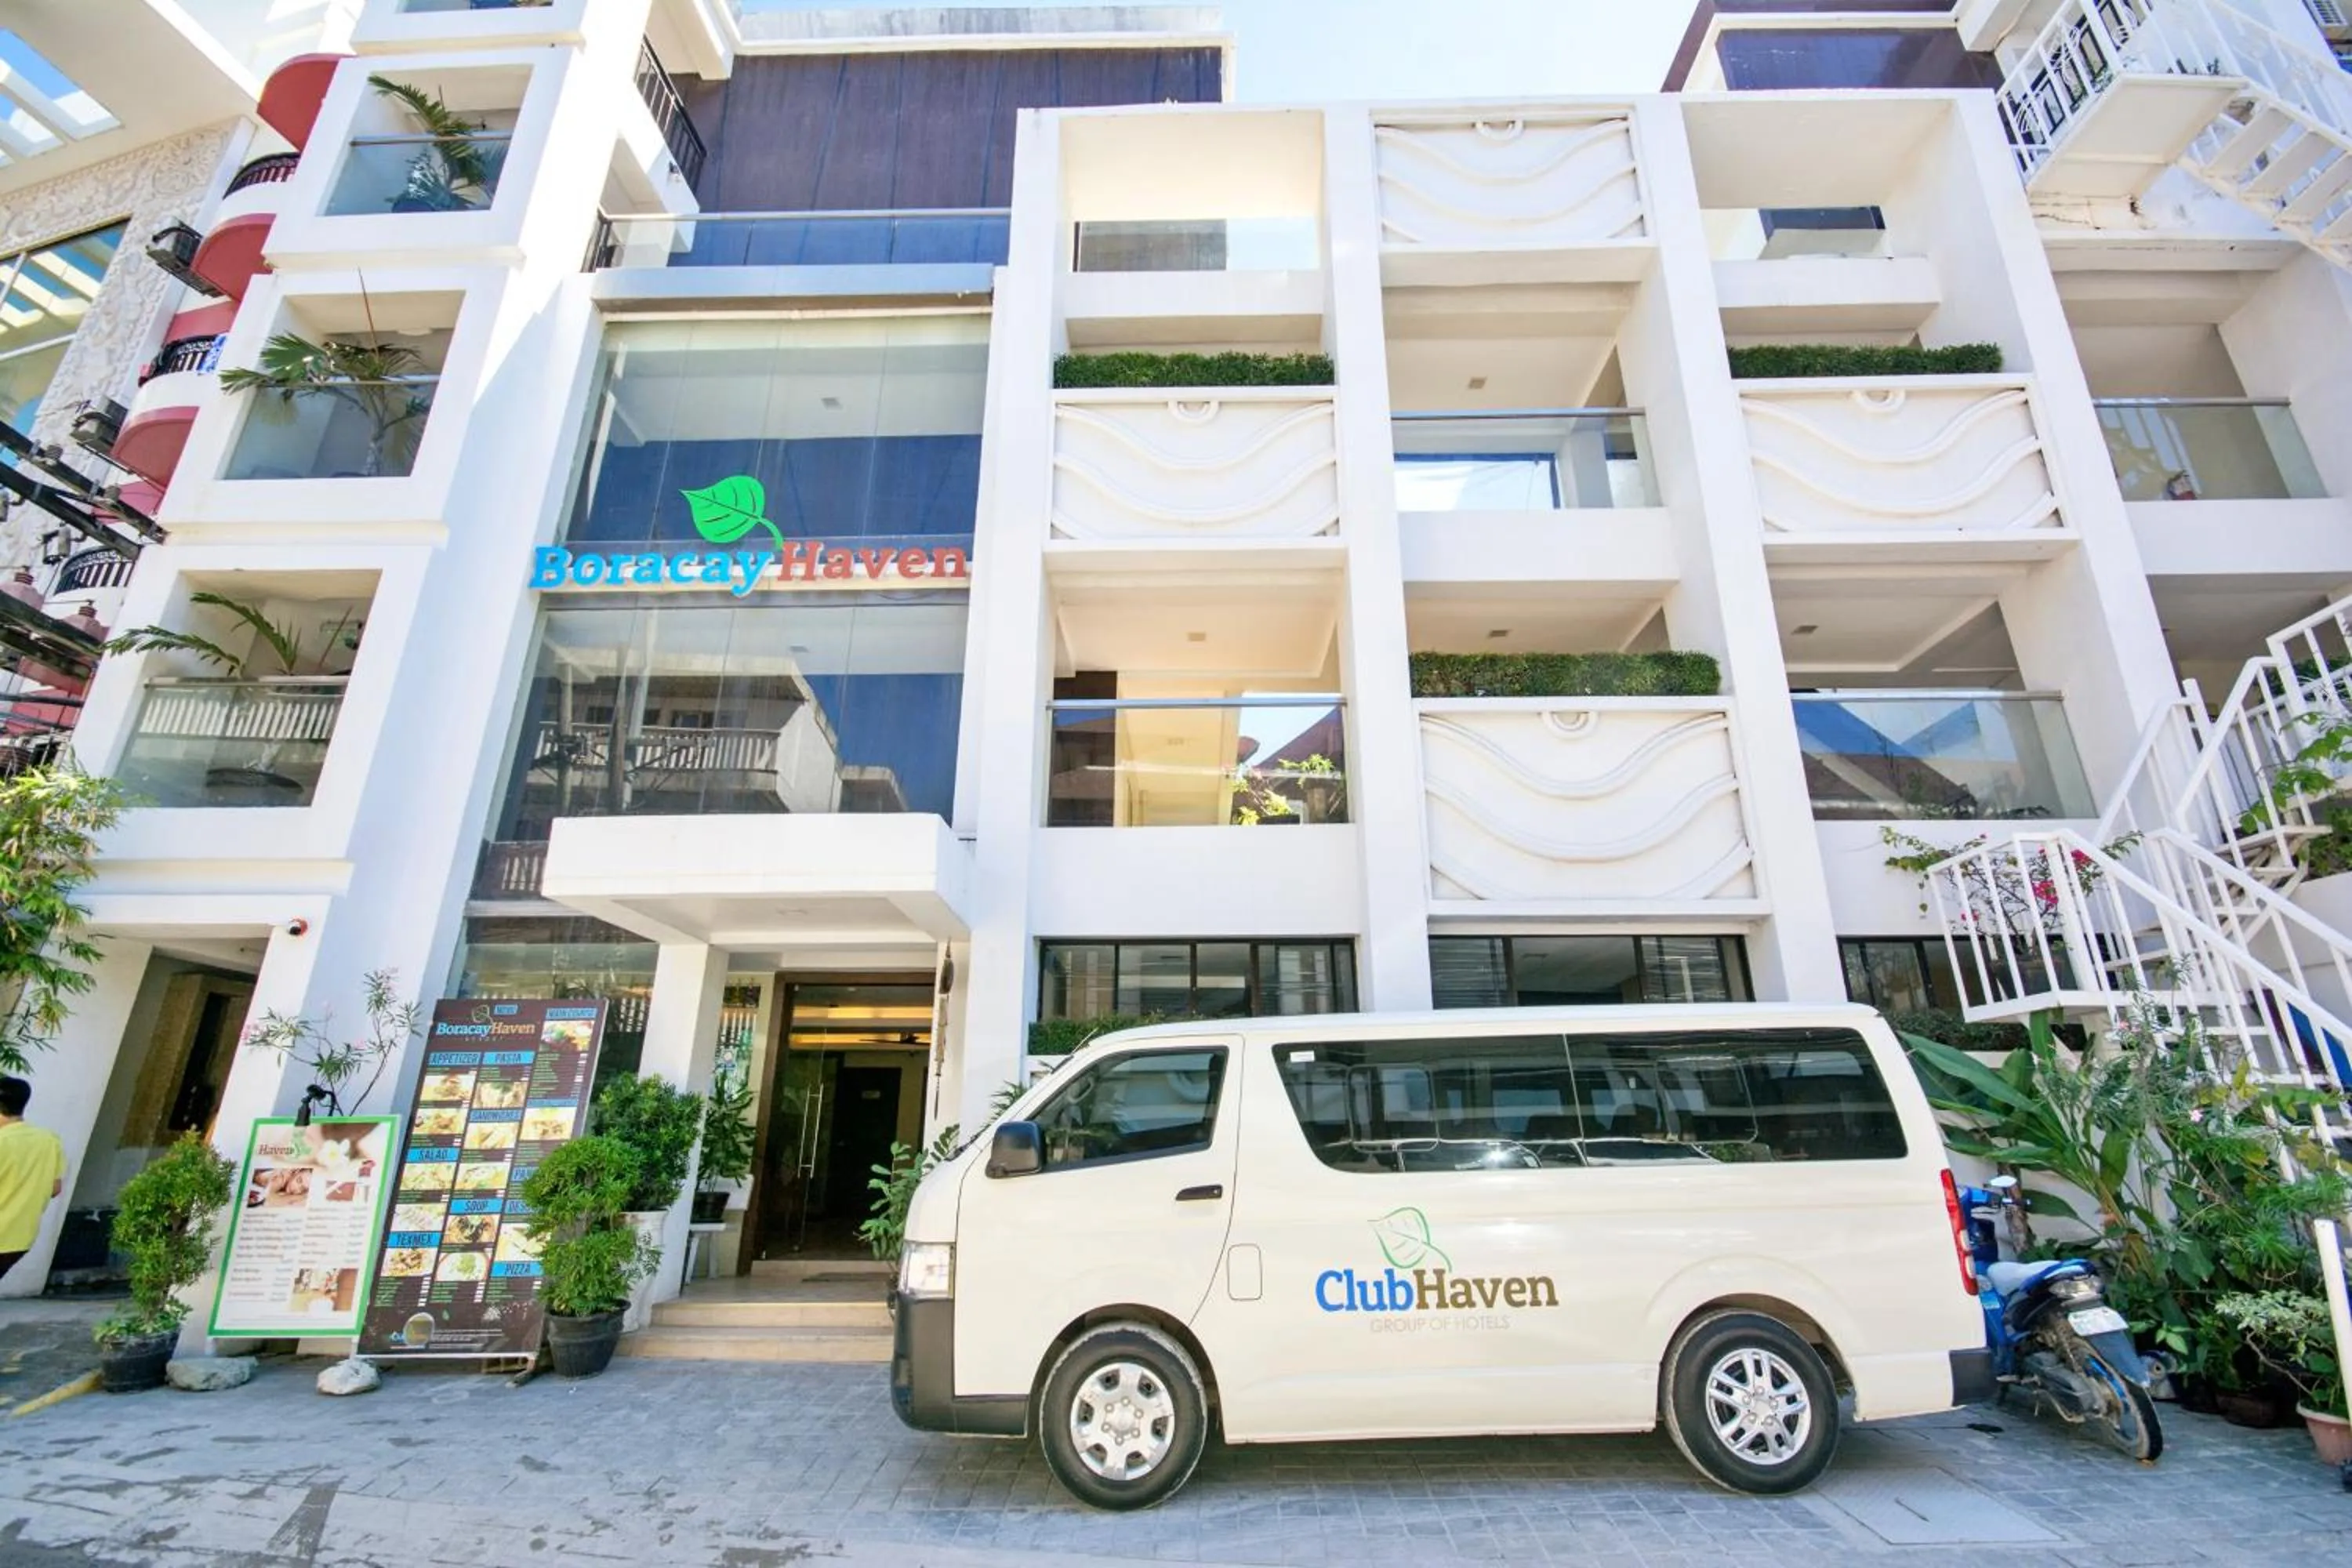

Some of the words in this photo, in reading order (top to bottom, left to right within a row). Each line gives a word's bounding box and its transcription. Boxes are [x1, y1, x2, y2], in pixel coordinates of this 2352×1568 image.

[431, 1052, 478, 1065] APPETIZER
[495, 1052, 521, 1063] PASTA
[419, 1149, 448, 1161] SALAD
[464, 1200, 488, 1211] SOUP
[396, 1233, 433, 1245] TEXMEX
[504, 1263, 531, 1275] PIZZA
[1370, 1318, 1426, 1334] GROUP
[1429, 1317, 1450, 1331] OF
[1454, 1315, 1511, 1330] HOTELS
